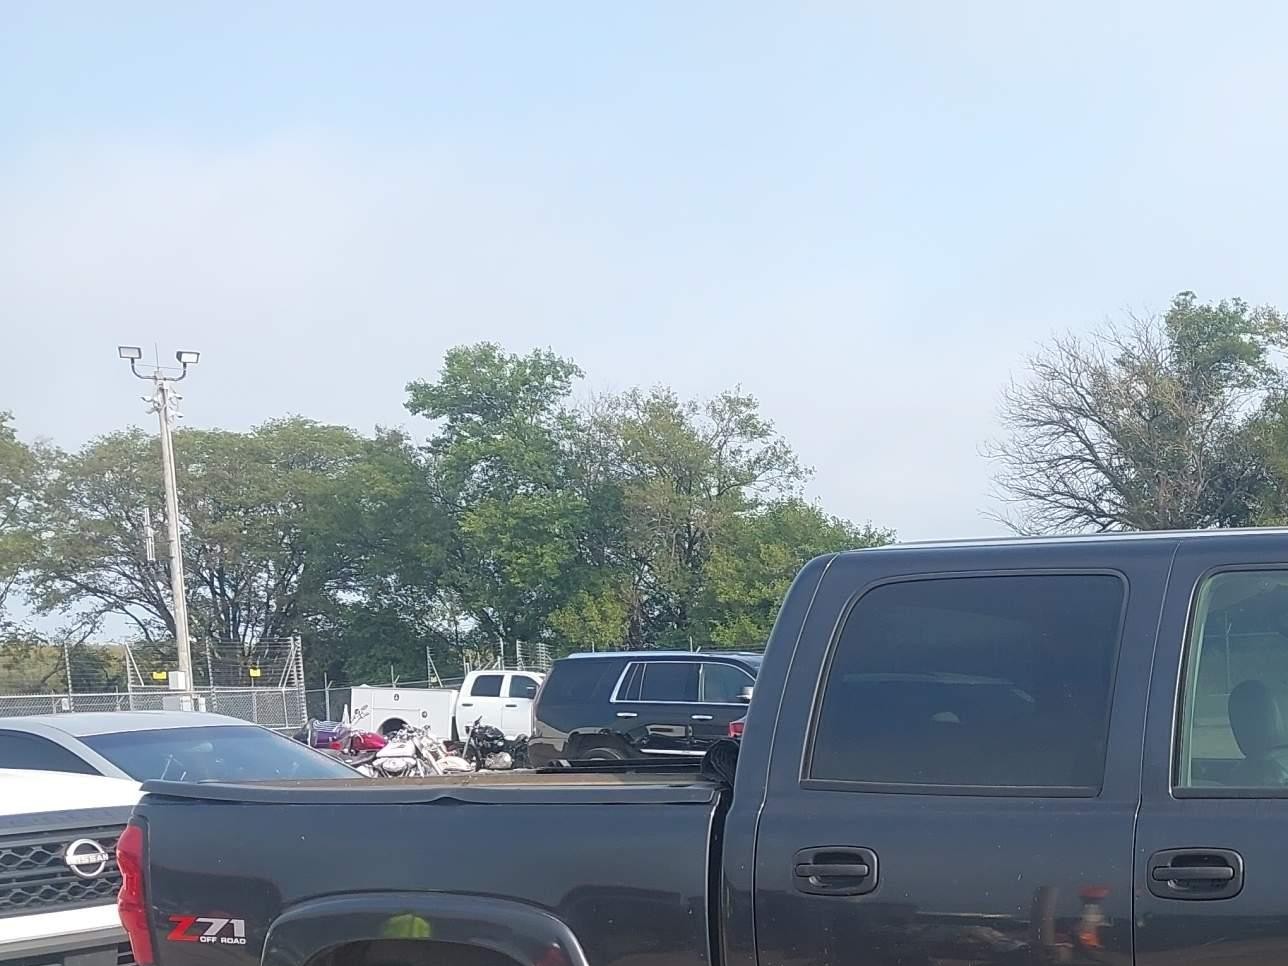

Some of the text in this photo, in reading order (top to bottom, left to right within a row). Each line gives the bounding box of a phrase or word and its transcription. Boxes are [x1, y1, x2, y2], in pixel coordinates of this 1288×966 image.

[66, 853, 108, 865] ISSAN
[167, 914, 246, 941] Z71
[220, 937, 247, 945] ROAD
